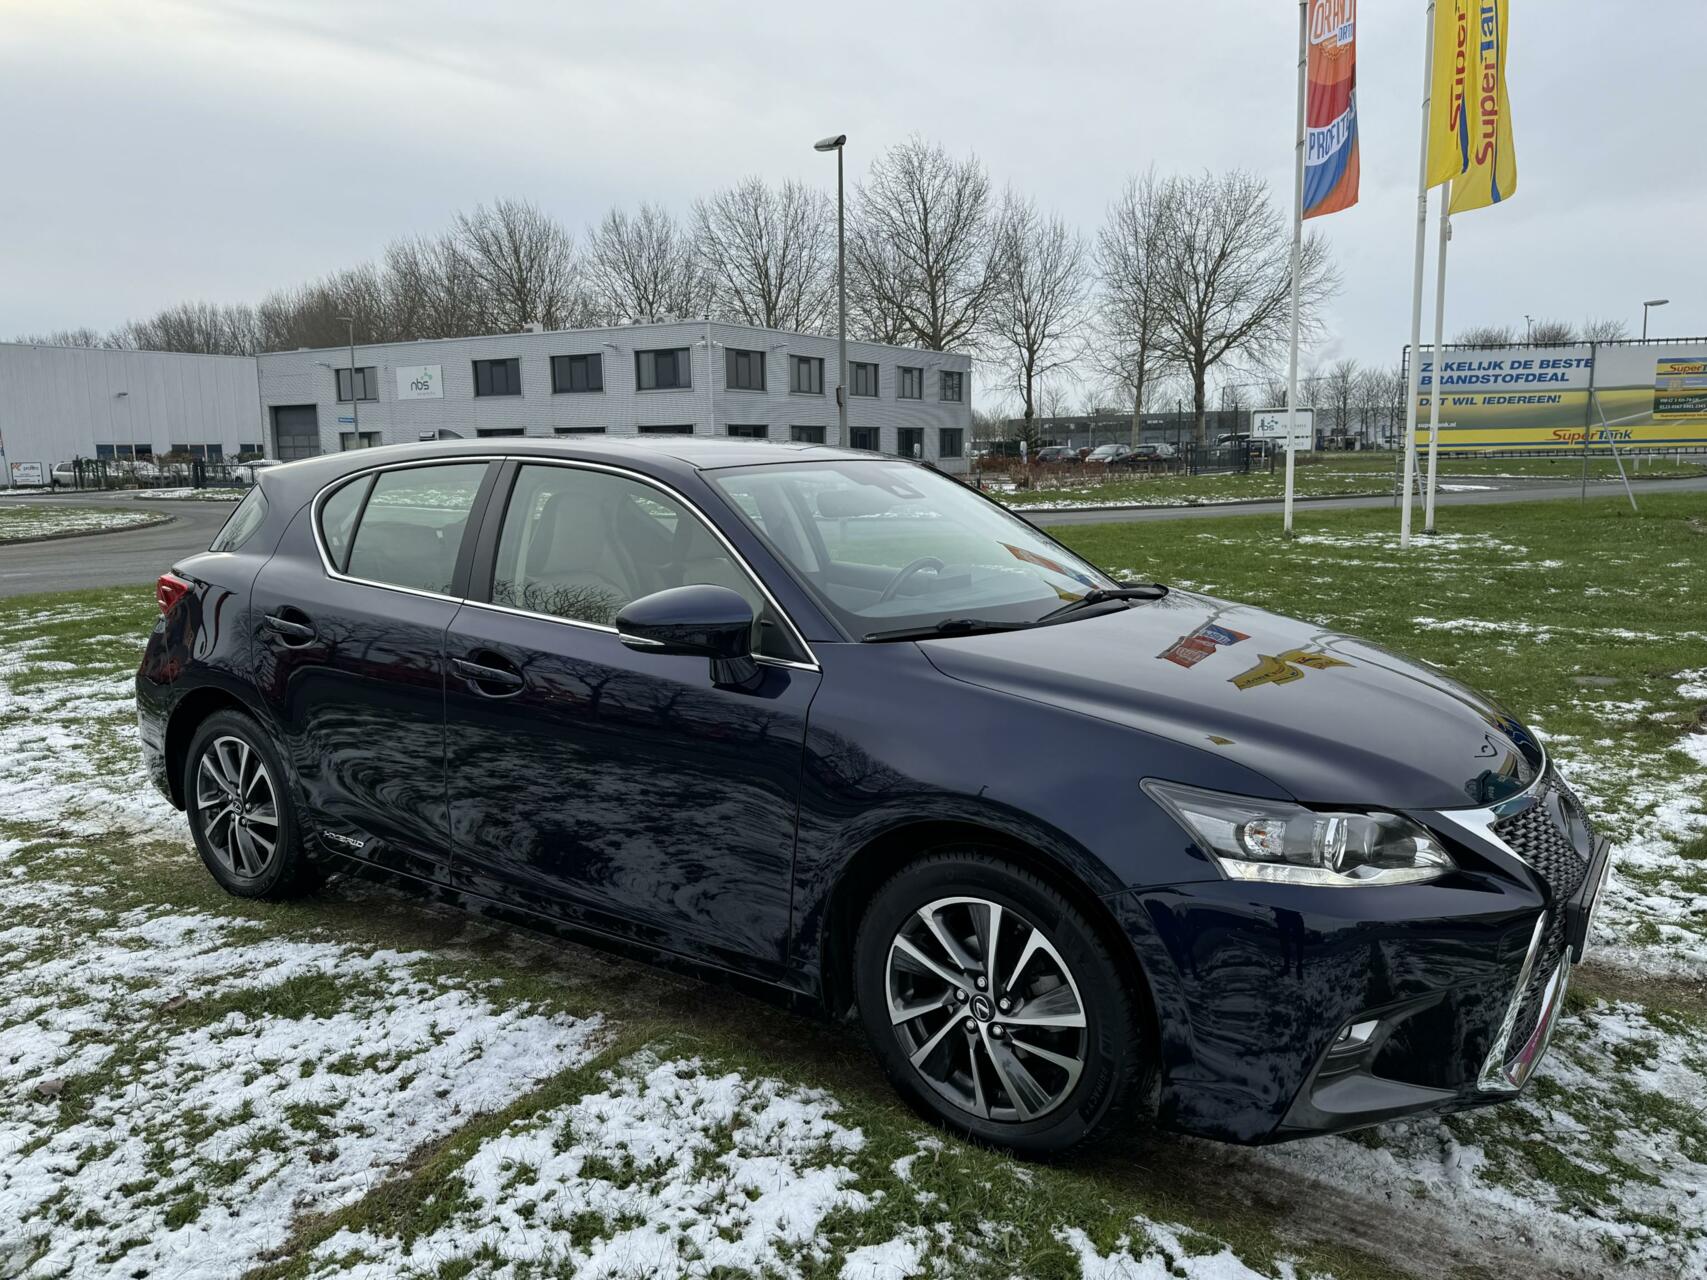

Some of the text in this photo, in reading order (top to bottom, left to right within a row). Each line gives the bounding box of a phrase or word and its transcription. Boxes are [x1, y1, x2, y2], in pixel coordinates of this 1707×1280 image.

[1421, 358, 1592, 372] ZKELIJK DE BESTE
[410, 378, 430, 391] nbs
[1419, 395, 1562, 406] DT WIL IEDEREEN!
[1550, 429, 1633, 445] SuperTank
